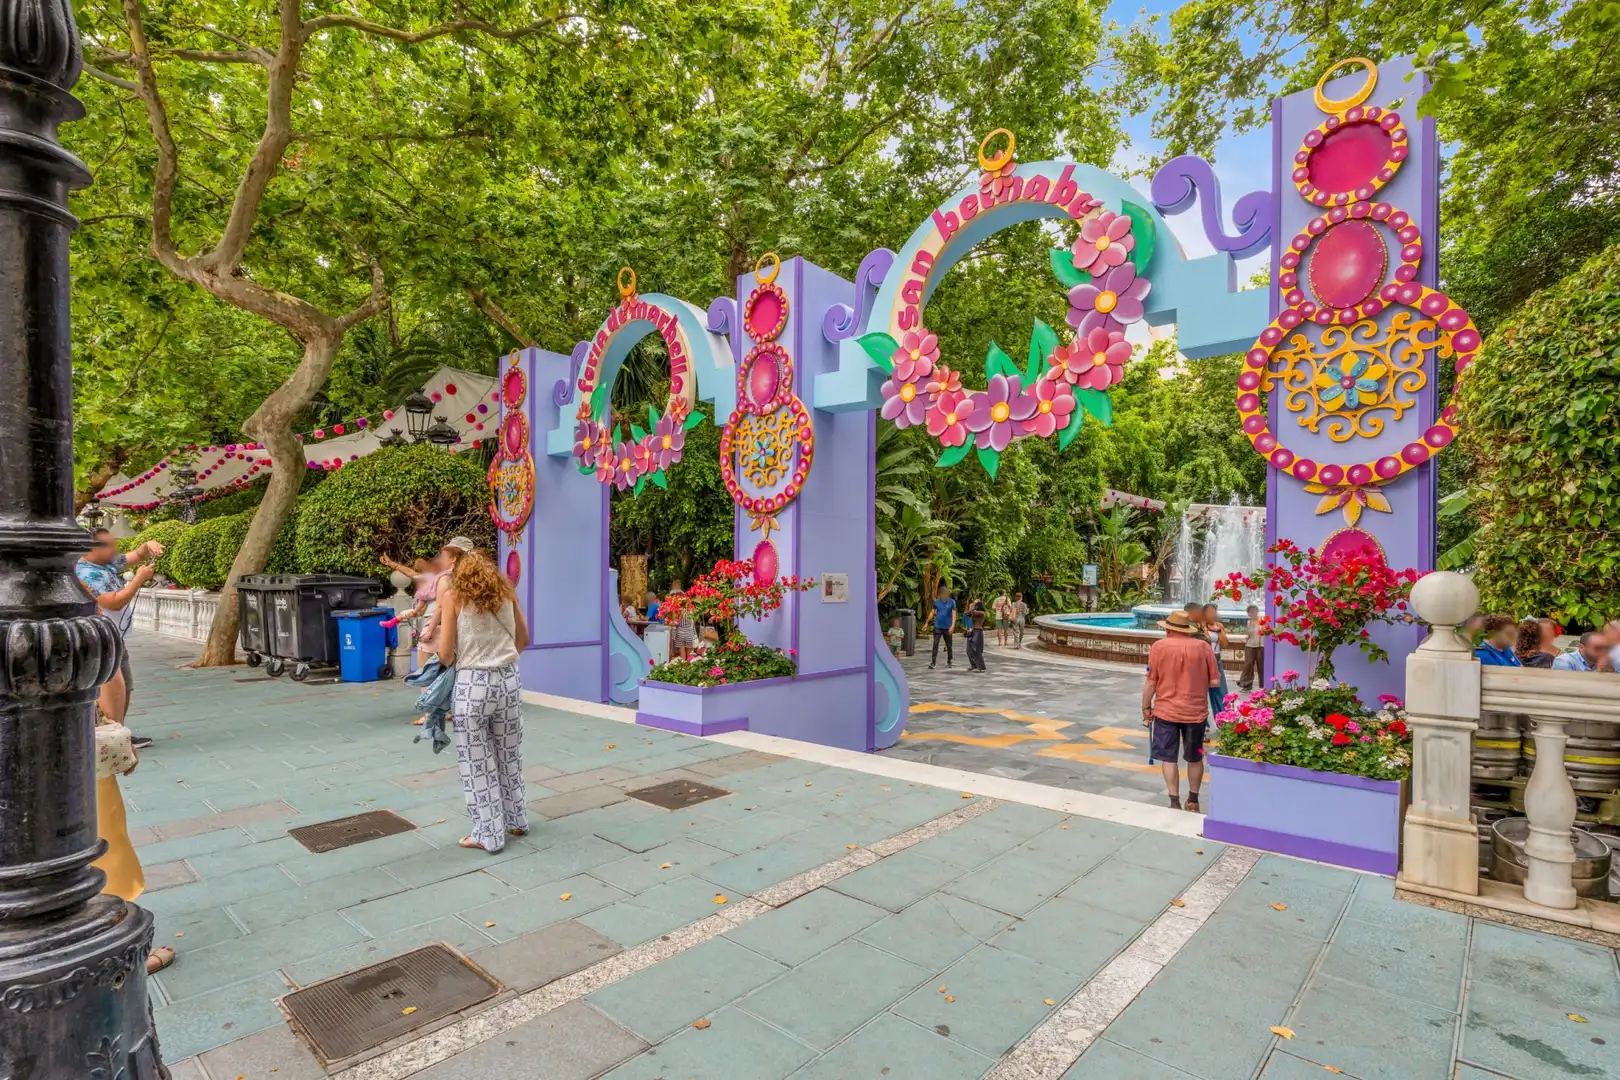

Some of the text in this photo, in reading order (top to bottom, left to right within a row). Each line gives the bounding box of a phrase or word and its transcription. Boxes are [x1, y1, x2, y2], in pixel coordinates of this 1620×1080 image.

[898, 249, 934, 330] san
[578, 301, 688, 394] feria de marbella
